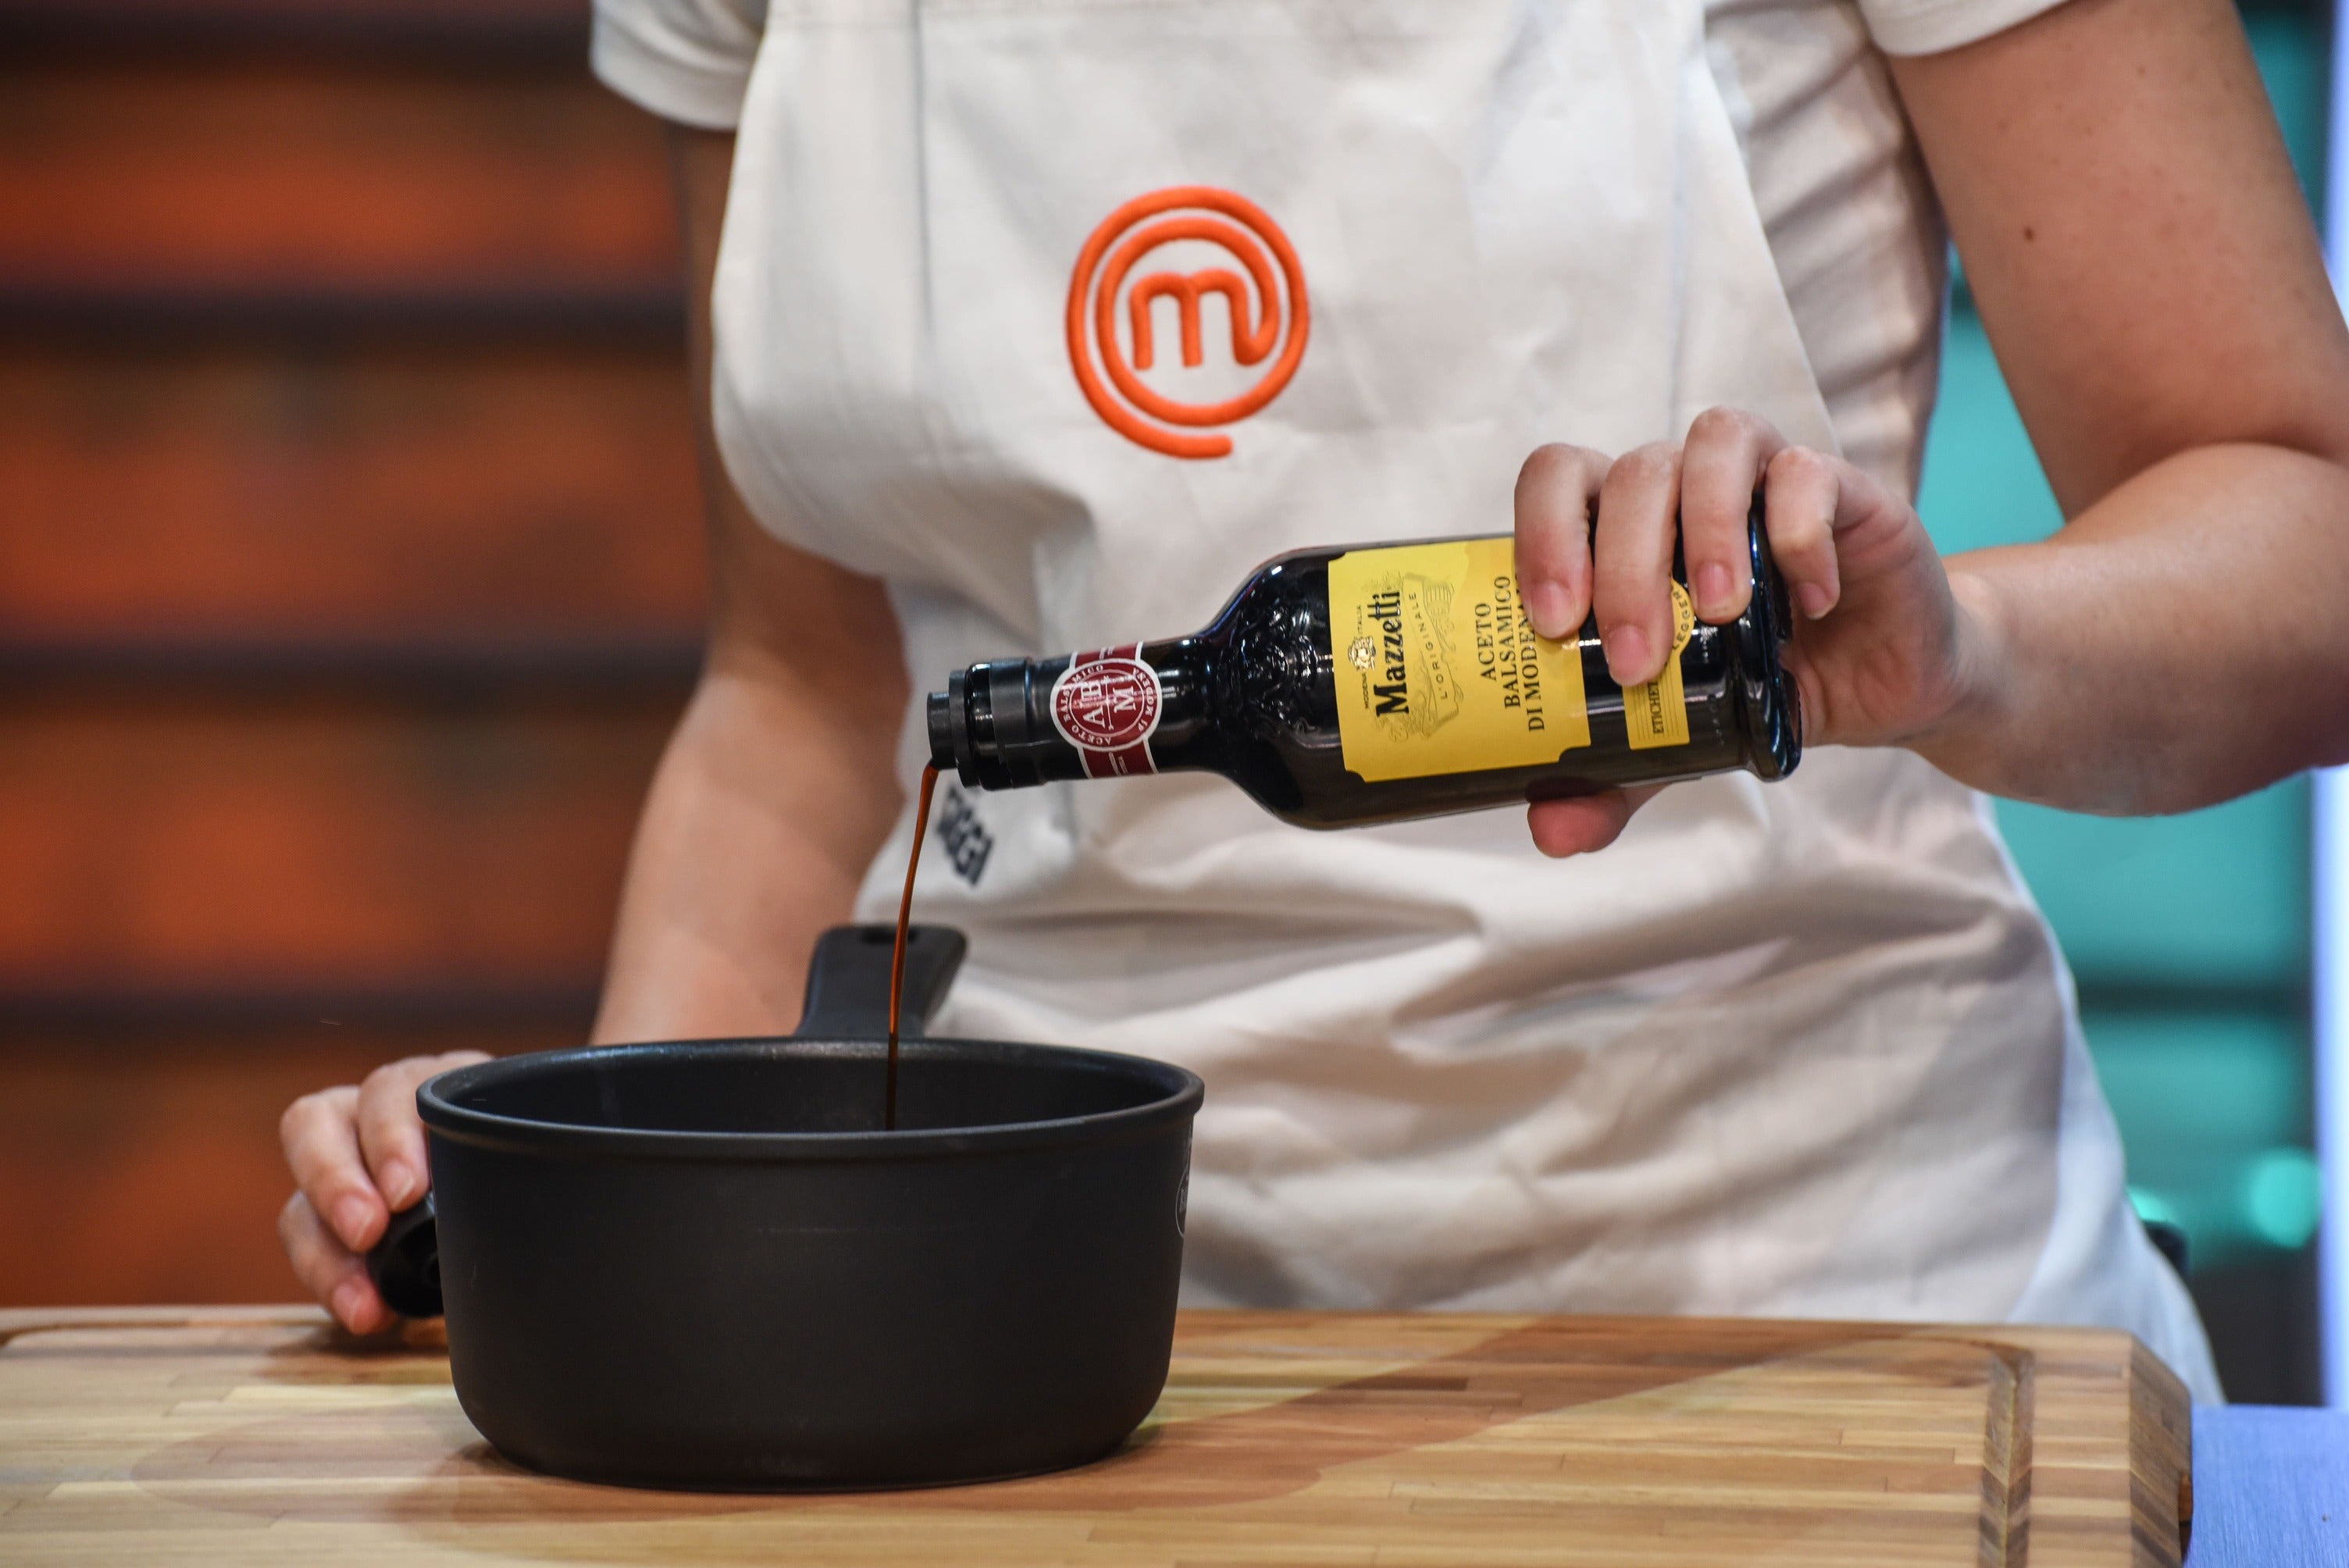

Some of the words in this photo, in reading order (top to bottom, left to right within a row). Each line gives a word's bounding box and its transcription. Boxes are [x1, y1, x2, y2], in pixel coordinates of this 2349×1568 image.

[1367, 591, 1410, 718] Mazzetti
[1408, 593, 1448, 700] L'ORIGINALE
[1474, 603, 1497, 682] ACETO
[1494, 576, 1521, 709] BALSAMICO
[1671, 586, 1691, 650] LEGGER
[1132, 667, 1154, 717] MODENA
[1527, 706, 1545, 732] DI
